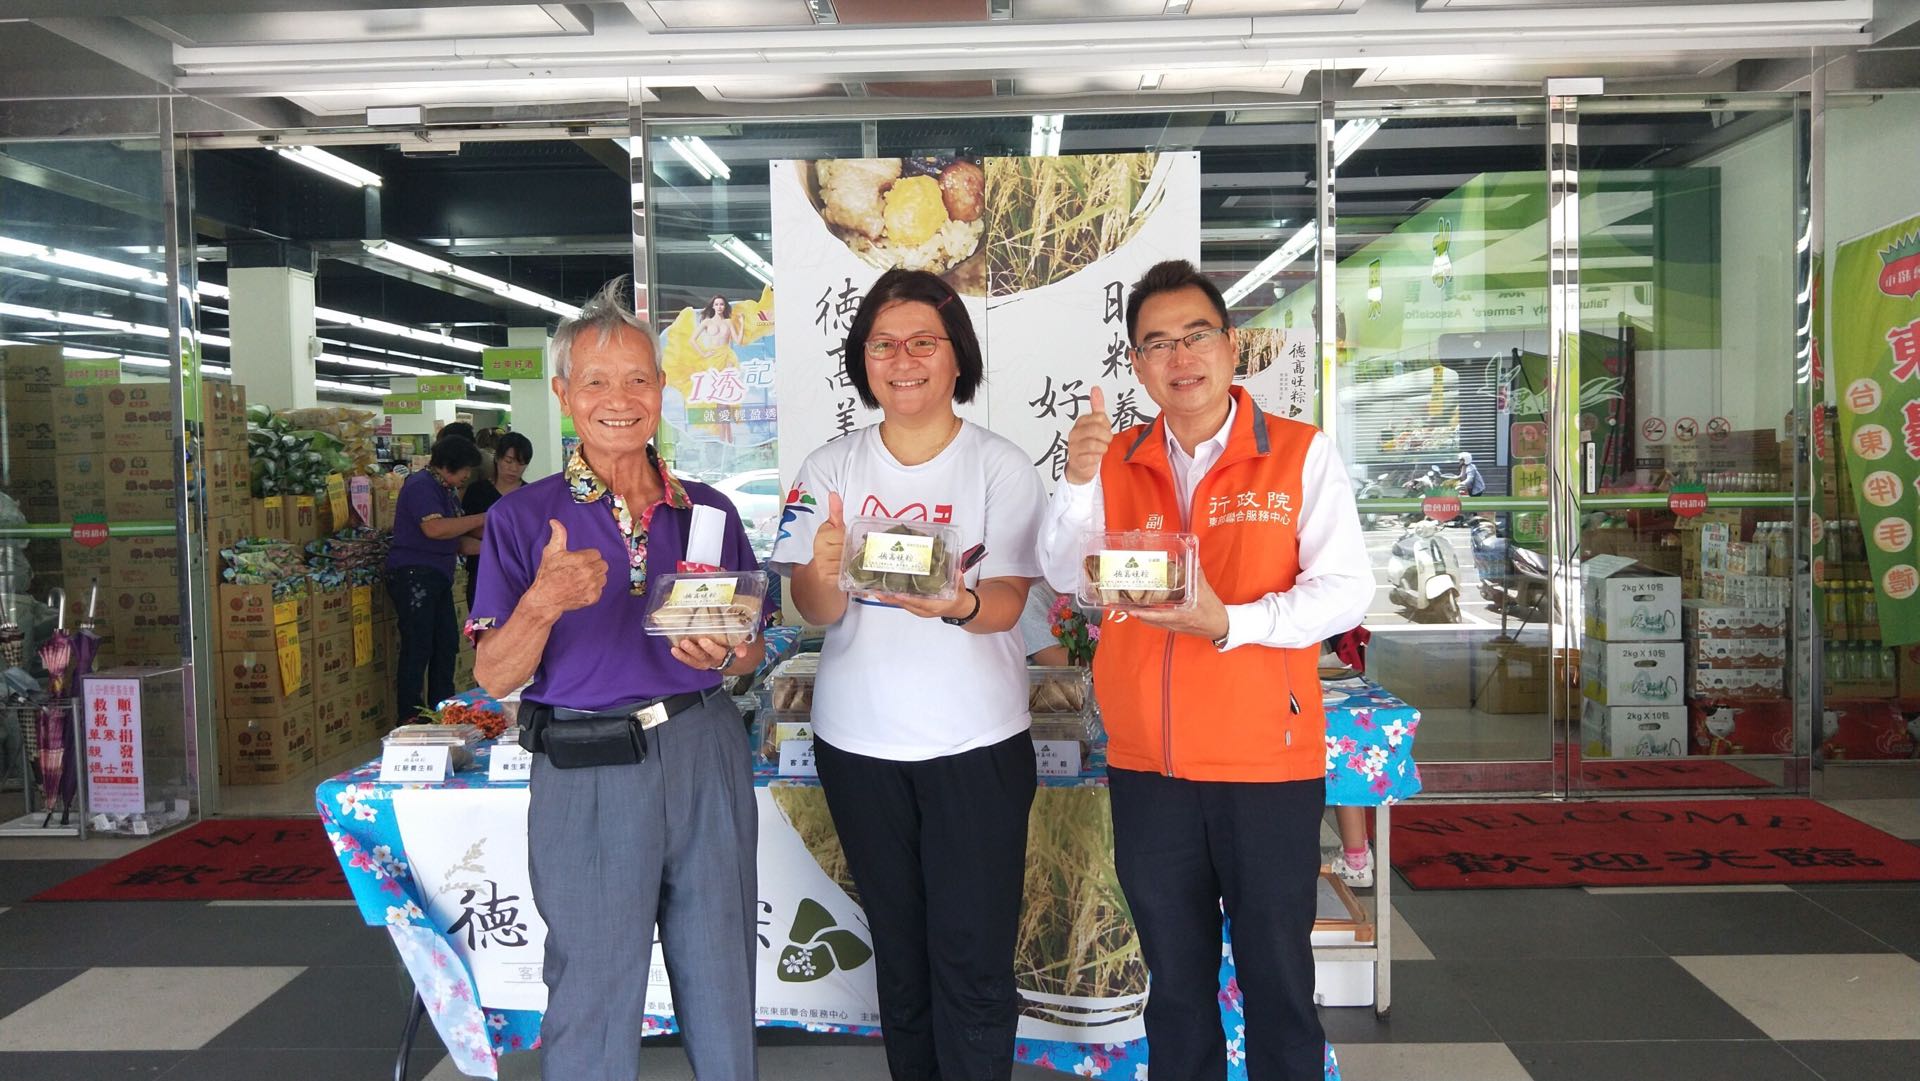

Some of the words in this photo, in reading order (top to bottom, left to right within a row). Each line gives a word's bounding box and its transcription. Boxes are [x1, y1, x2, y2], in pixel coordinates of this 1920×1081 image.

[1288, 341, 1306, 404] 德高旺粽
[1208, 491, 1293, 515] 行政院
[1145, 512, 1164, 530] 副
[1208, 510, 1291, 528] 東部聯合服務中心
[1621, 584, 1637, 592] 2kg
[1622, 650, 1638, 659] 2kg
[1626, 712, 1642, 721] 2kg
[1397, 808, 1812, 836] WELCOME
[1437, 846, 1884, 876] 歡迎光臨
[112, 864, 349, 886] 歡迎
